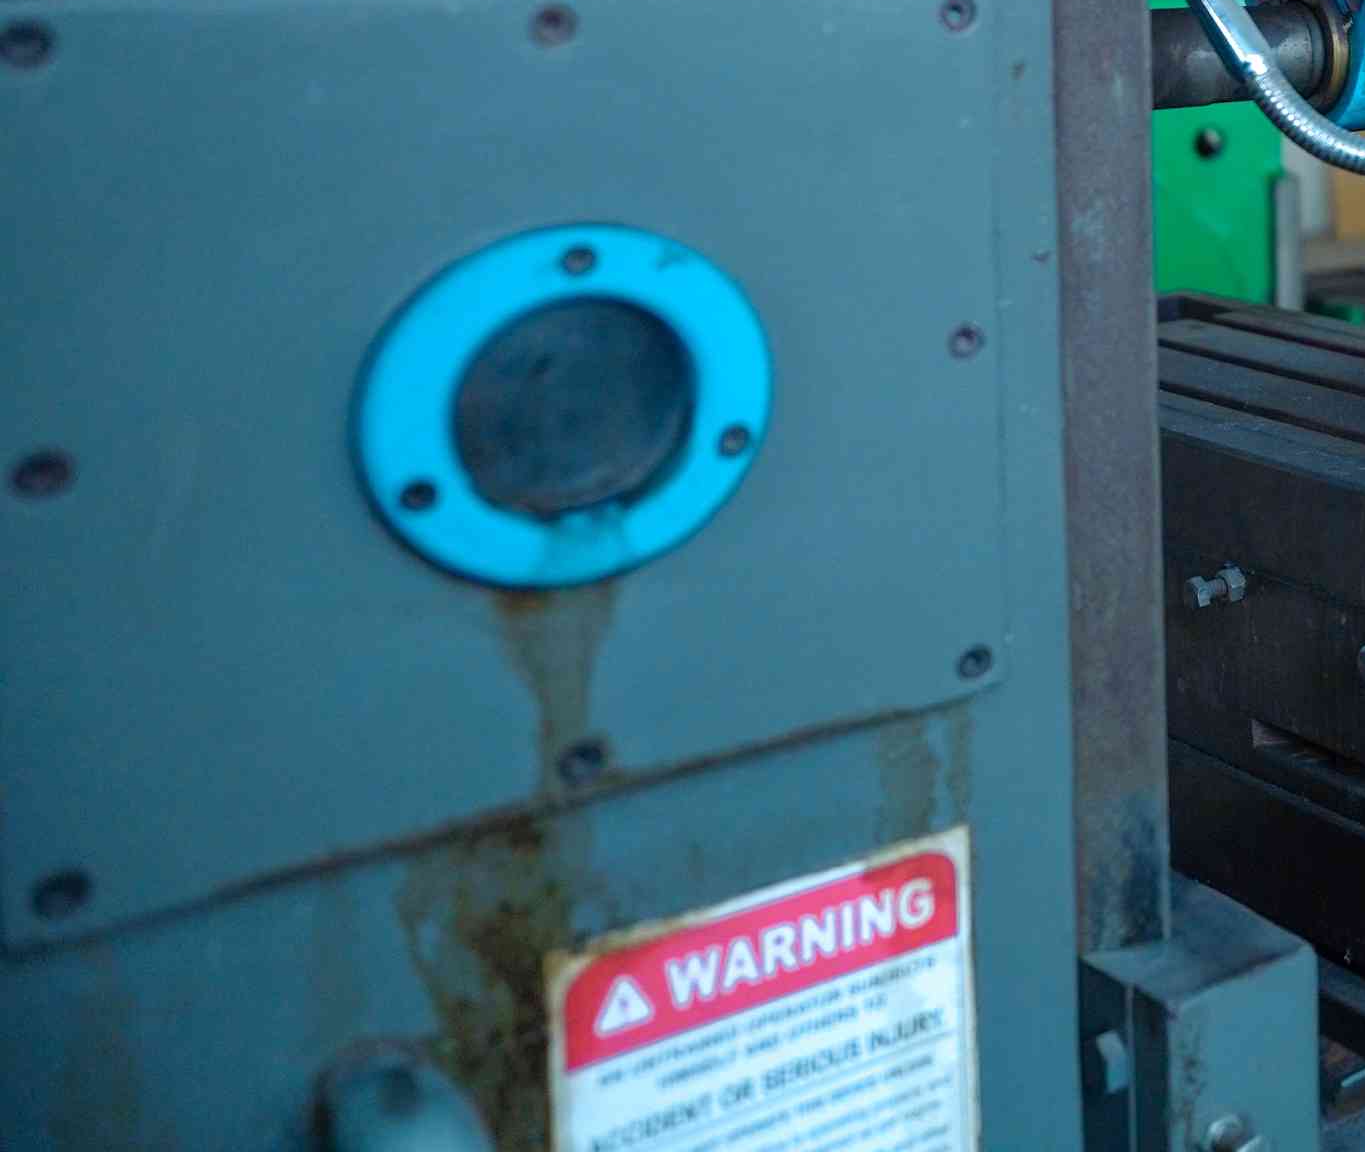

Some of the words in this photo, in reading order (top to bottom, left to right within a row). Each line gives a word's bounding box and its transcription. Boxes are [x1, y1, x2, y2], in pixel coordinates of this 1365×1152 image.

[665, 877, 936, 1010] WARNING
[718, 1079, 754, 1108] OR
[763, 1037, 861, 1091] SERIOUS
[868, 1008, 944, 1053] INJURY
